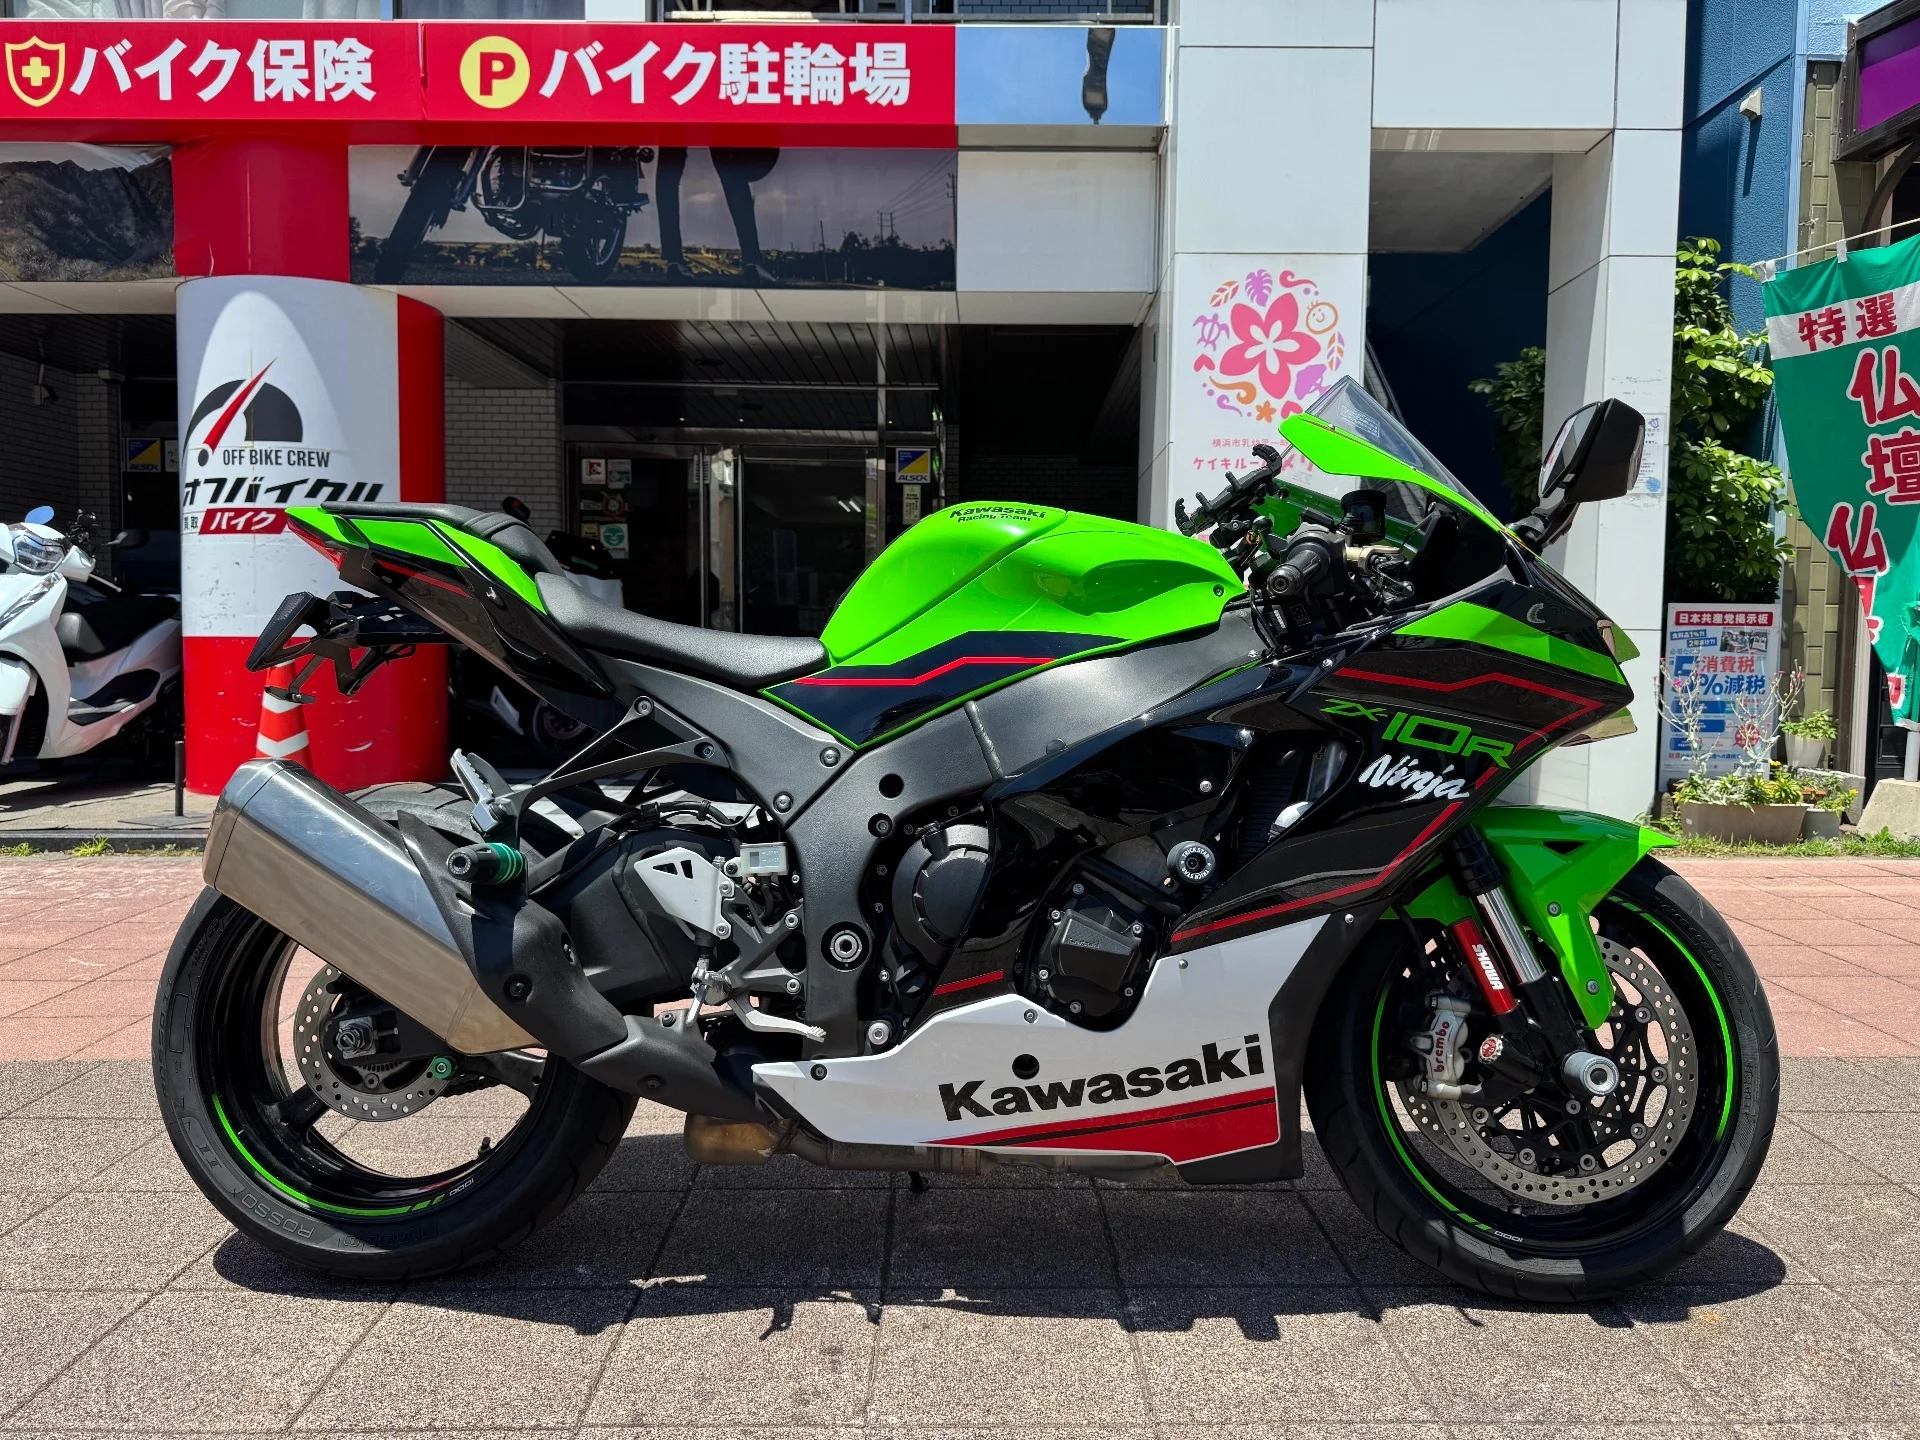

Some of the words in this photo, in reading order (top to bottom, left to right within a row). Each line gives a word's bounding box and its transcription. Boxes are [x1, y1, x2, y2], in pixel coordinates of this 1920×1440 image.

[70, 38, 376, 103] バイク保険
[539, 42, 911, 106] バイク駐輪場
[1798, 291, 1898, 351] 特選
[222, 449, 245, 466] OFF
[249, 449, 283, 466] BIKE
[287, 450, 331, 468] CREW
[898, 474, 928, 482] ALSOK
[209, 511, 276, 531] バイク
[949, 506, 1047, 519] Kawasaki
[957, 513, 997, 523] Racing
[1000, 513, 1031, 522] Team
[1678, 612, 1769, 625] 日本共産党掲示板
[1701, 655, 1755, 673] 消費税
[1319, 698, 1515, 769] ZX-10R
[1357, 753, 1470, 803] Ninja
[1471, 943, 1504, 991] SHOWA
[1433, 1020, 1450, 1073] brembo
[936, 1032, 1266, 1122] Kawasaki
[241, 1193, 315, 1240] ROSSO
